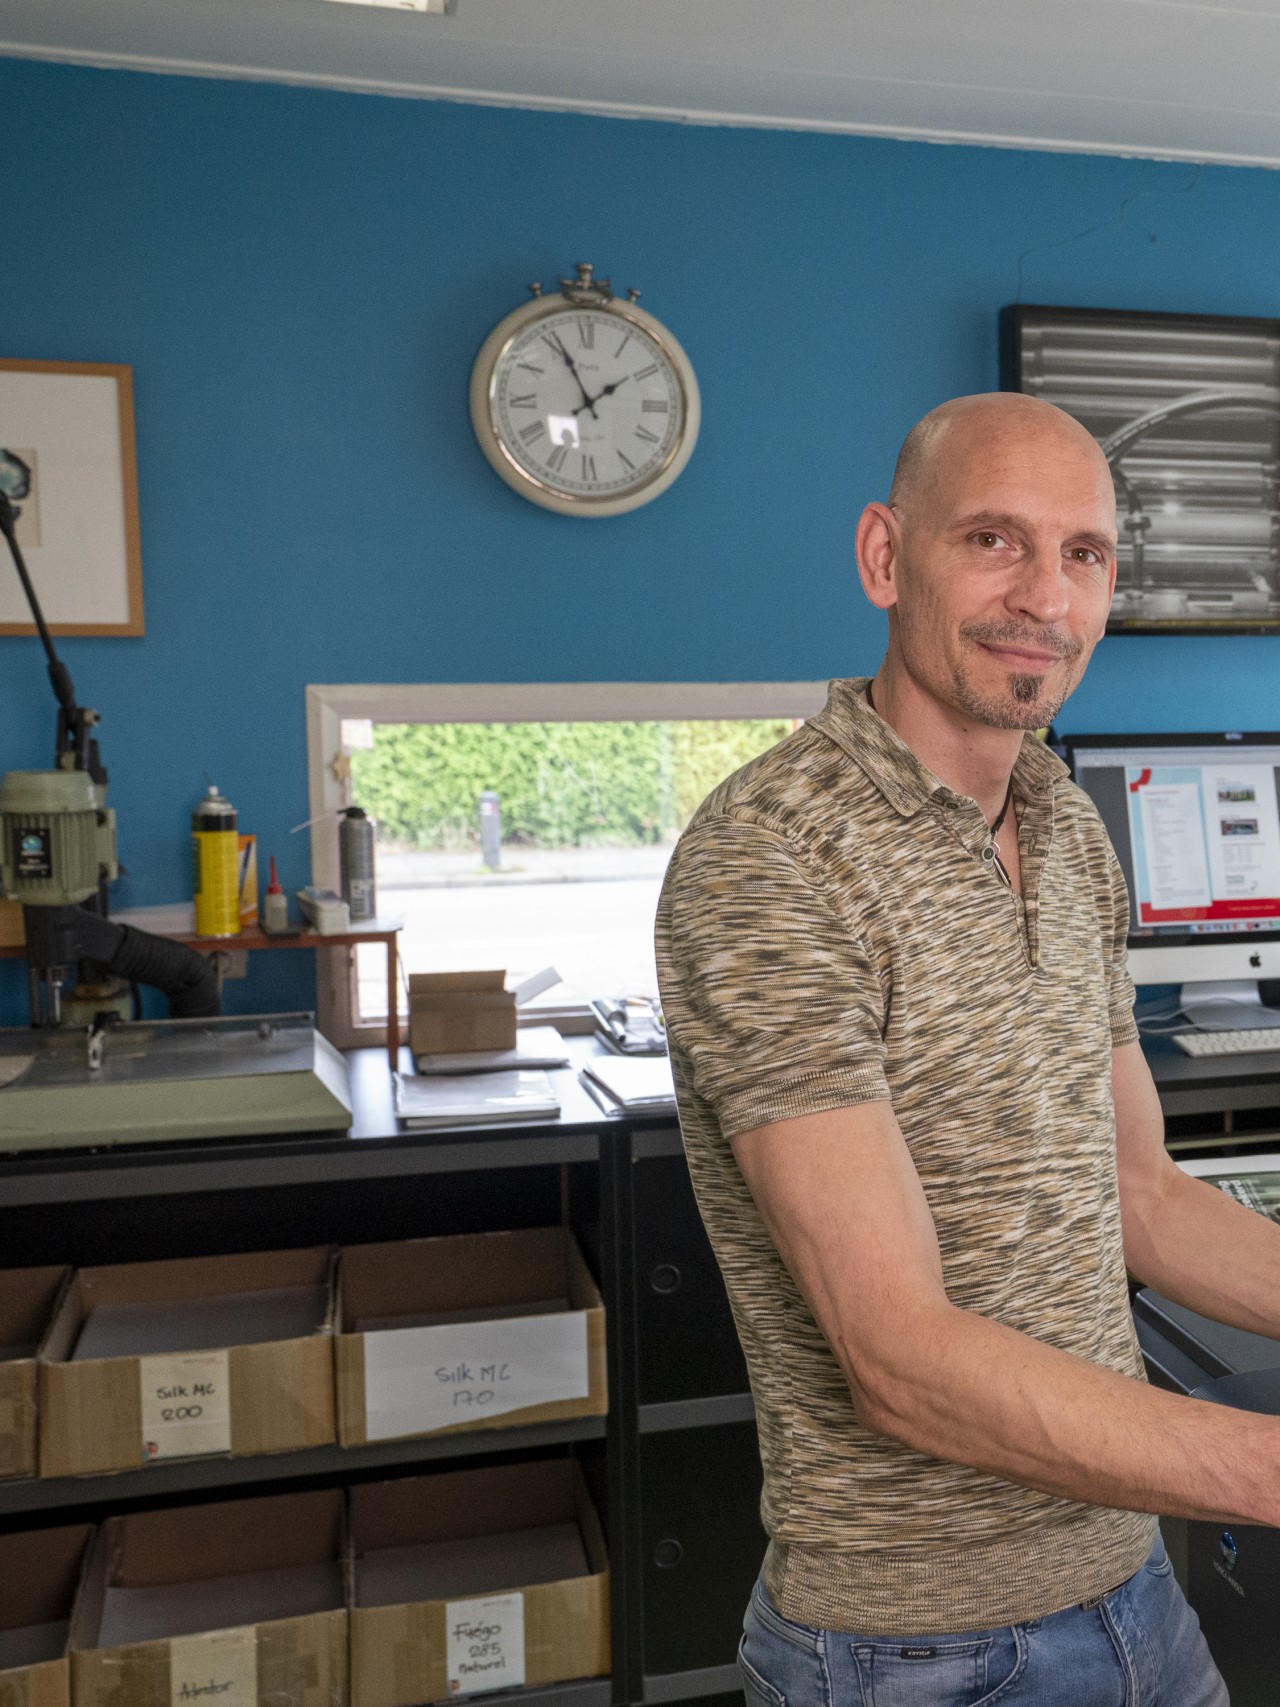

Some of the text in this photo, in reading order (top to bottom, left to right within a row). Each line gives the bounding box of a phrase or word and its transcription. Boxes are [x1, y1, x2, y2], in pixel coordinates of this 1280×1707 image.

[434, 1362, 474, 1383] Silk
[156, 1385, 188, 1400] Silk
[161, 1405, 203, 1421] 200
